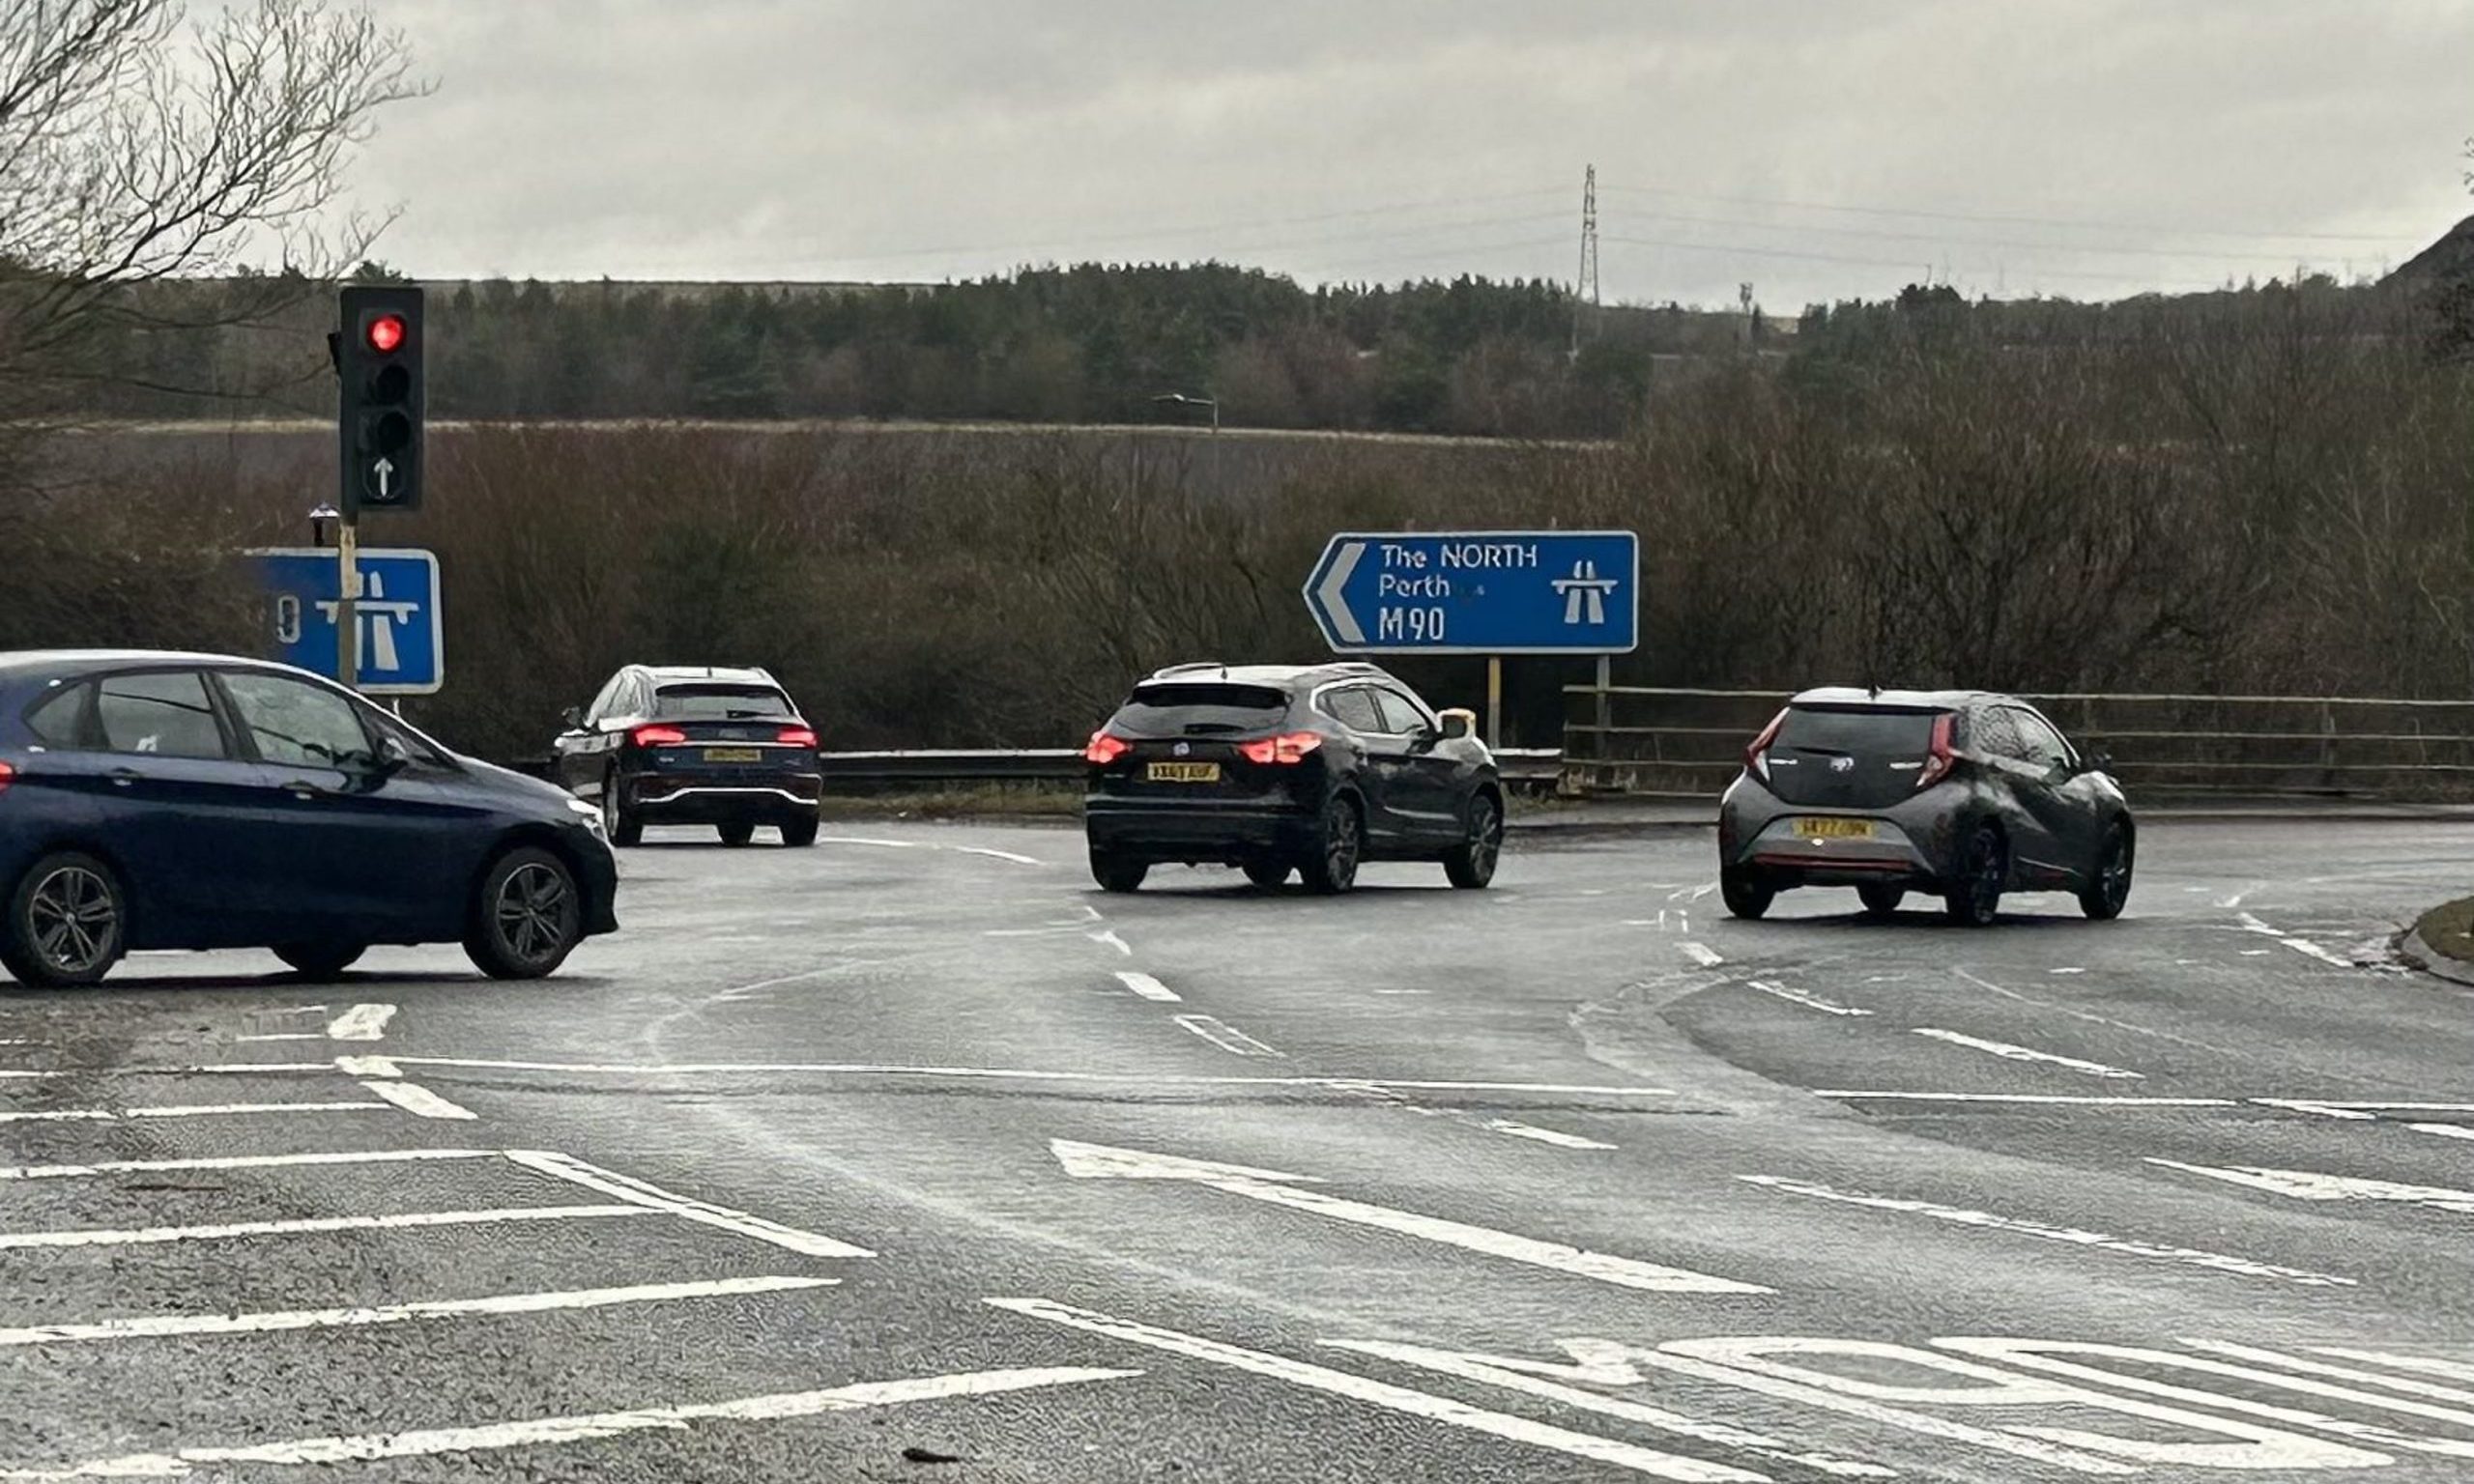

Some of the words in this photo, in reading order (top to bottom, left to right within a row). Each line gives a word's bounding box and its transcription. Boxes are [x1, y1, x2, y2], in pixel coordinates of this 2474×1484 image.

[1379, 544, 1427, 568] The
[1440, 544, 1538, 568] NORTH
[1379, 574, 1451, 598] Perth
[1378, 607, 1445, 641] M90
